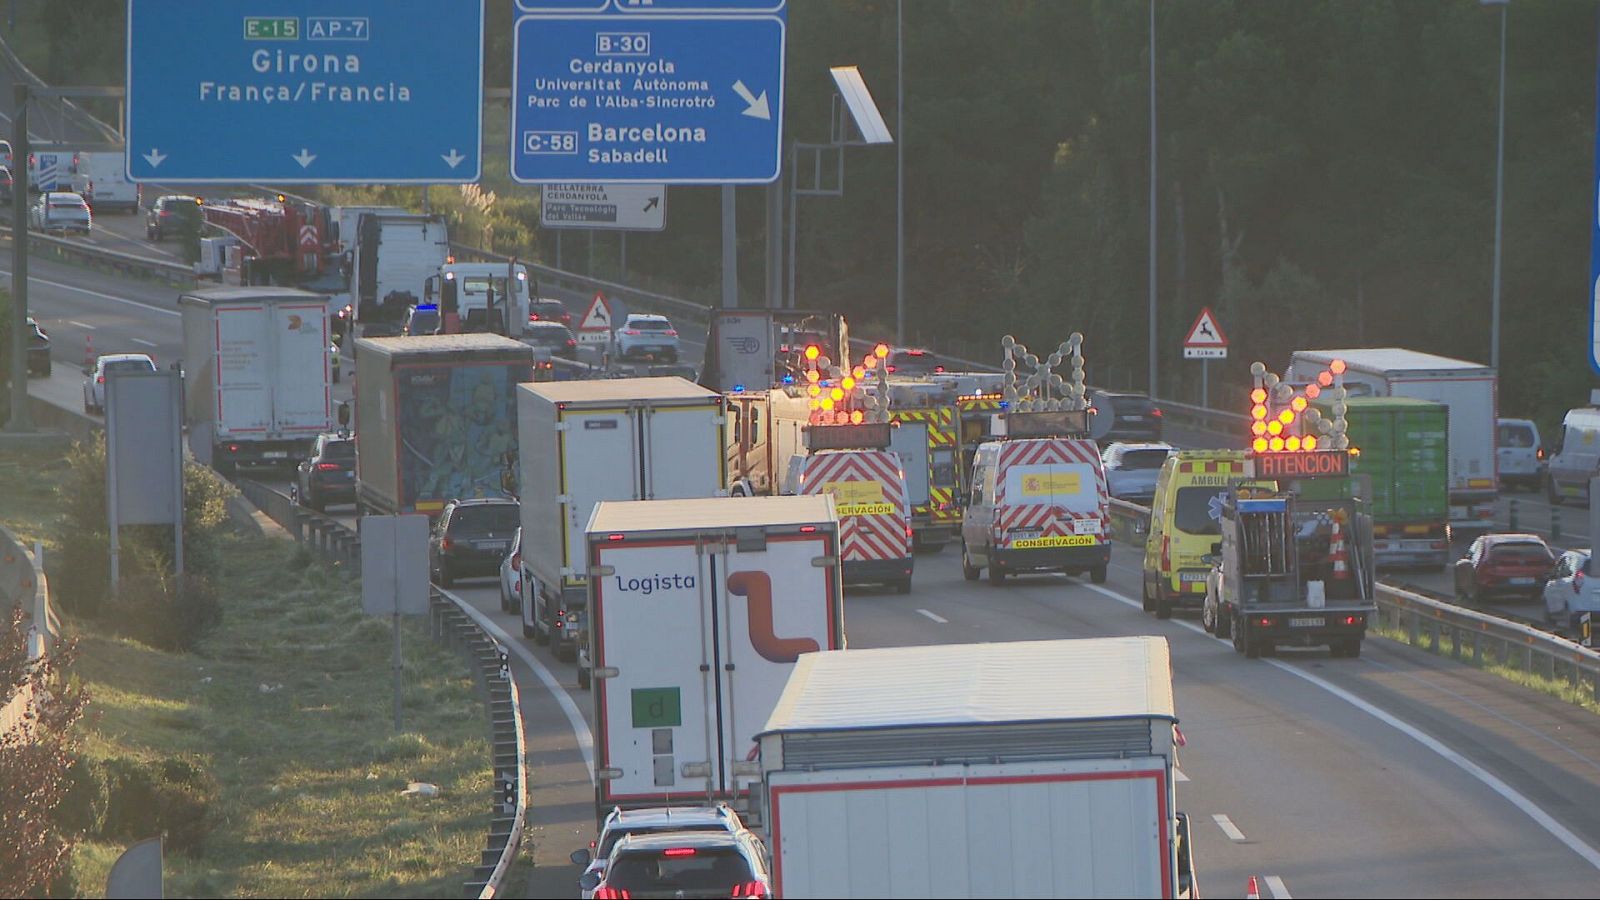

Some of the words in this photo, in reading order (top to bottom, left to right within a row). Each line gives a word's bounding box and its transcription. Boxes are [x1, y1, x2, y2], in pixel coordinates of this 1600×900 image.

[247, 21, 296, 37] E-15
[312, 21, 365, 37] AP-7
[598, 35, 646, 53] B-30
[252, 48, 361, 73] Girona
[569, 58, 675, 77] Cerdanyola
[535, 78, 621, 91] Universitat
[633, 77, 709, 91] Autònoma
[199, 81, 411, 104] França/Francia
[528, 96, 560, 108] Parc
[569, 95, 587, 108] de
[595, 94, 716, 108] l'Alba-Sincrotró
[588, 123, 706, 142] Barcelona
[527, 135, 574, 151] C-58
[588, 149, 668, 163] Sabadell
[547, 183, 604, 192] BELLATERRA
[547, 192, 608, 201] CERDANYOLA
[1263, 455, 1342, 475] ATENCION
[1015, 537, 1092, 548] CONSERVACIÓN
